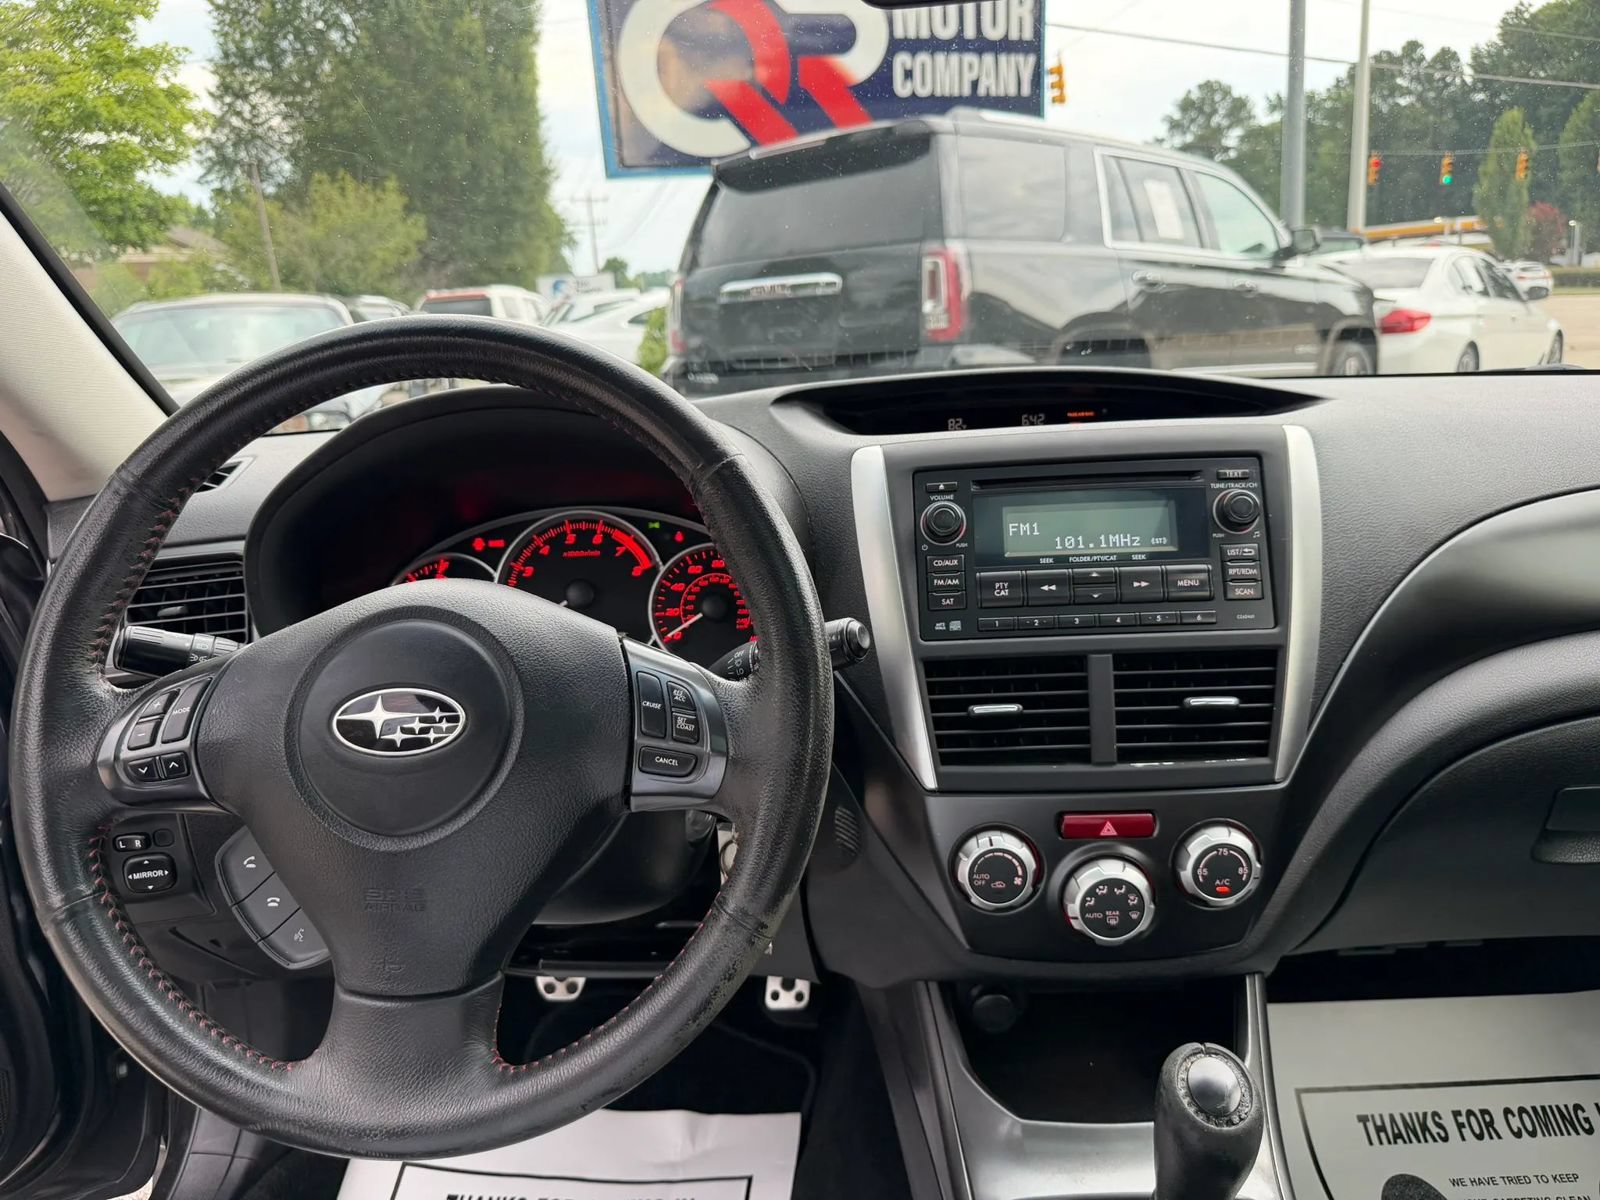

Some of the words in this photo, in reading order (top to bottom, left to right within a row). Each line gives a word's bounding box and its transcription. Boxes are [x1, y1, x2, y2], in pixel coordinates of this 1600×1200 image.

[893, 0, 1034, 40] MOTOR
[893, 51, 1036, 98] COMPANY
[1009, 523, 1040, 536] FM1
[1055, 534, 1141, 549] 101.1MHz
[933, 559, 959, 567] CD/AUX
[1228, 567, 1258, 575] RPT/RDM
[1177, 579, 1200, 587] MENU
[941, 598, 954, 606] SAT
[674, 695, 686, 703] ACC
[642, 700, 662, 710] CRUISE
[173, 706, 191, 715] MODE
[676, 723, 695, 732] COAST
[655, 756, 679, 766] CANCEL
[1217, 848, 1229, 856] 75
[133, 869, 164, 879] MIRROR
[1197, 868, 1208, 876] 65
[1238, 866, 1249, 874] 85
[1215, 878, 1230, 886] A/C
[1356, 1109, 1450, 1147] THANKS
[1451, 1107, 1503, 1142] FOR
[1503, 1102, 1596, 1140] COMING
[1449, 1177, 1467, 1187] WE
[1468, 1176, 1499, 1187] HAVE
[1499, 1175, 1532, 1186] TRIED
[1533, 1173, 1549, 1184] TO
[1551, 1172, 1580, 1183] KEEP
